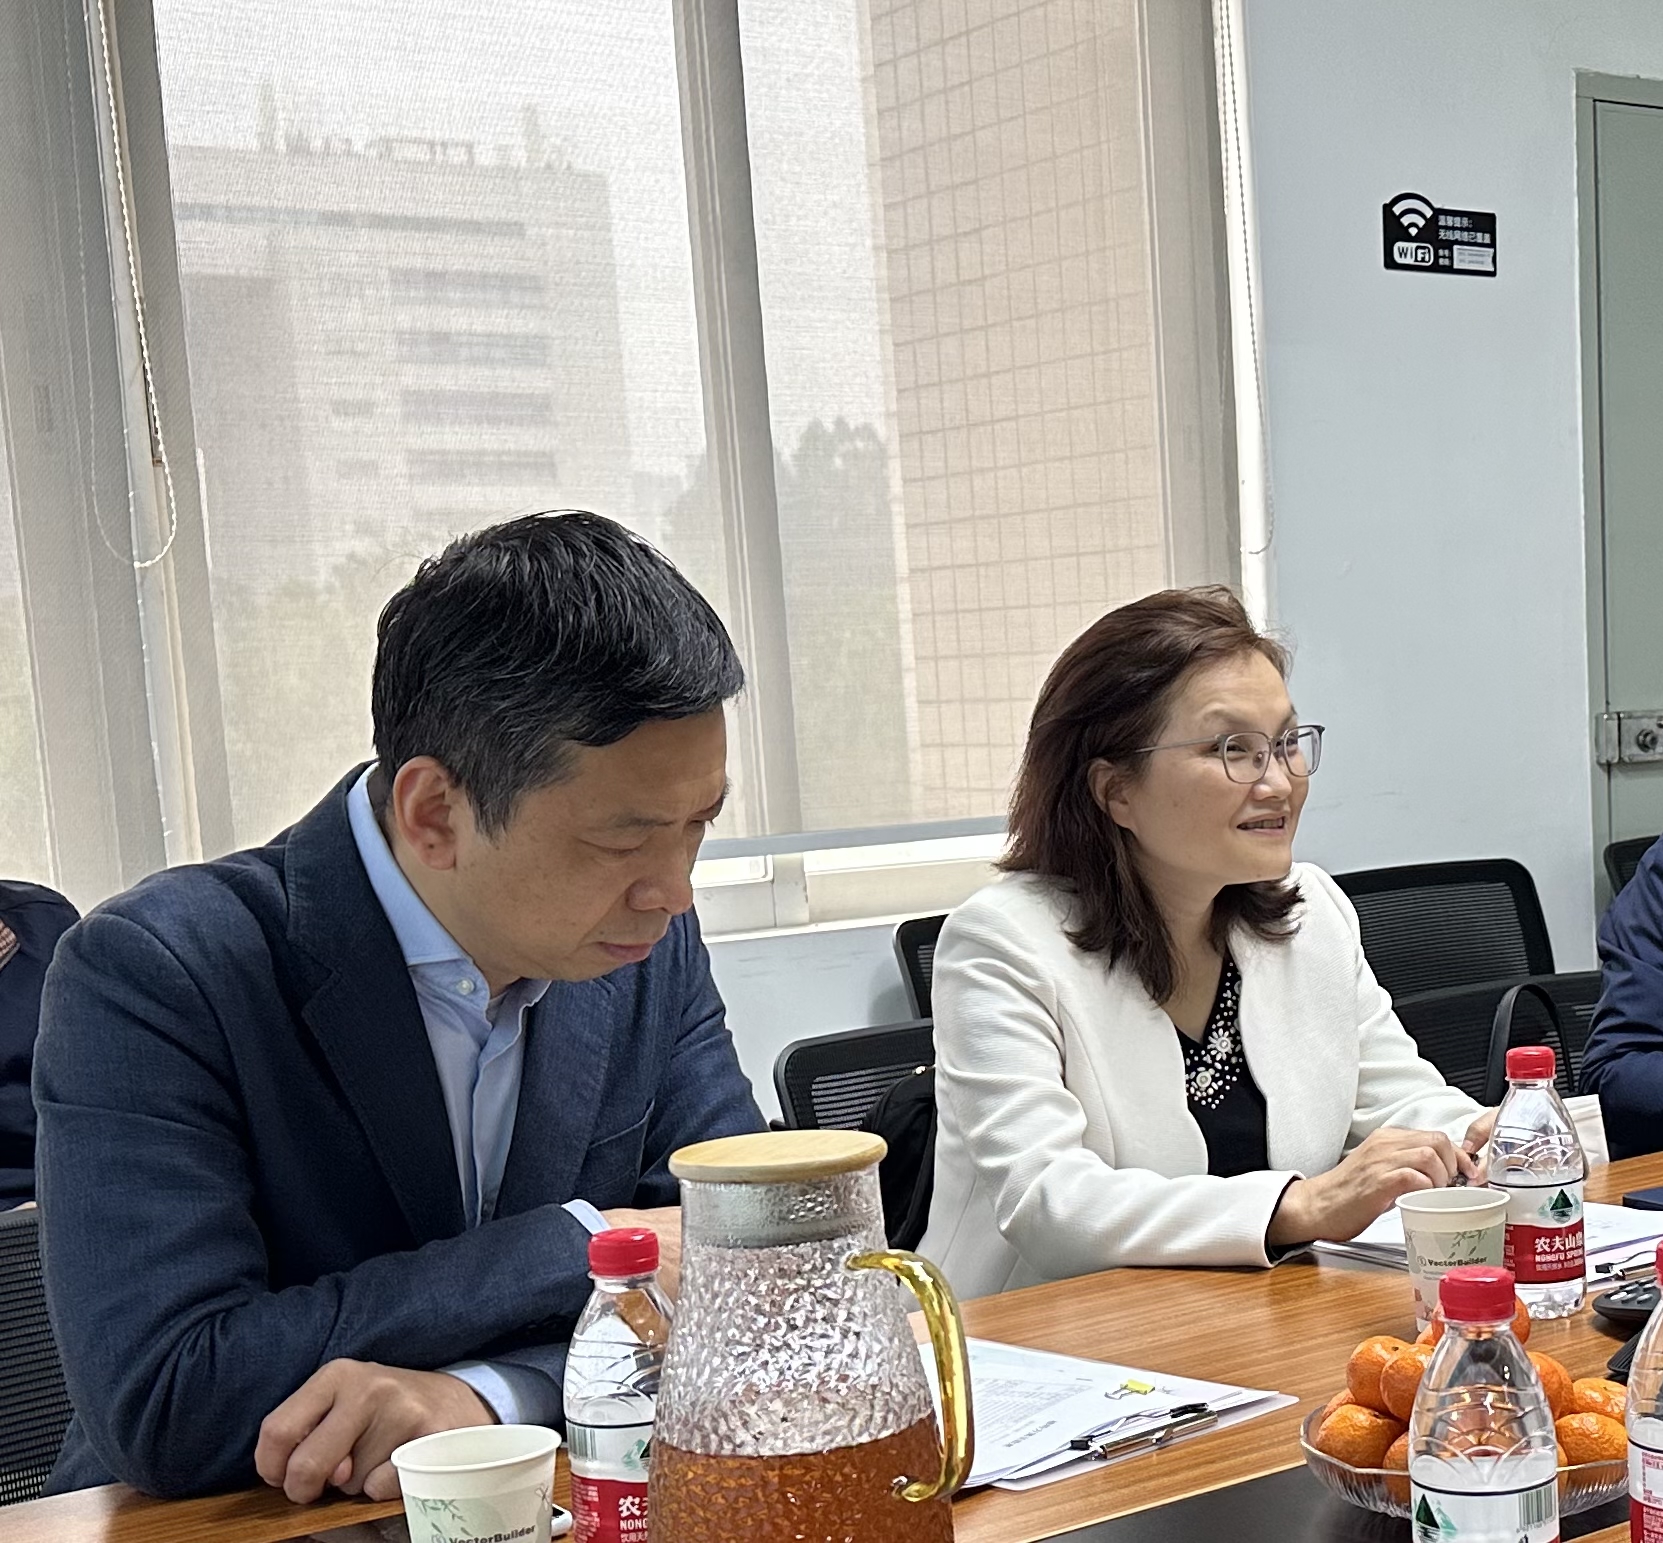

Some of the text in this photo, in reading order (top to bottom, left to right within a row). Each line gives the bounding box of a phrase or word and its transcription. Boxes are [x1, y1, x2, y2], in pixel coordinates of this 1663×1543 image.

[1428, 1255, 1488, 1267] VectorBuilder
[620, 1518, 648, 1531] NONG
[448, 1525, 536, 1543] VectorBuilder
